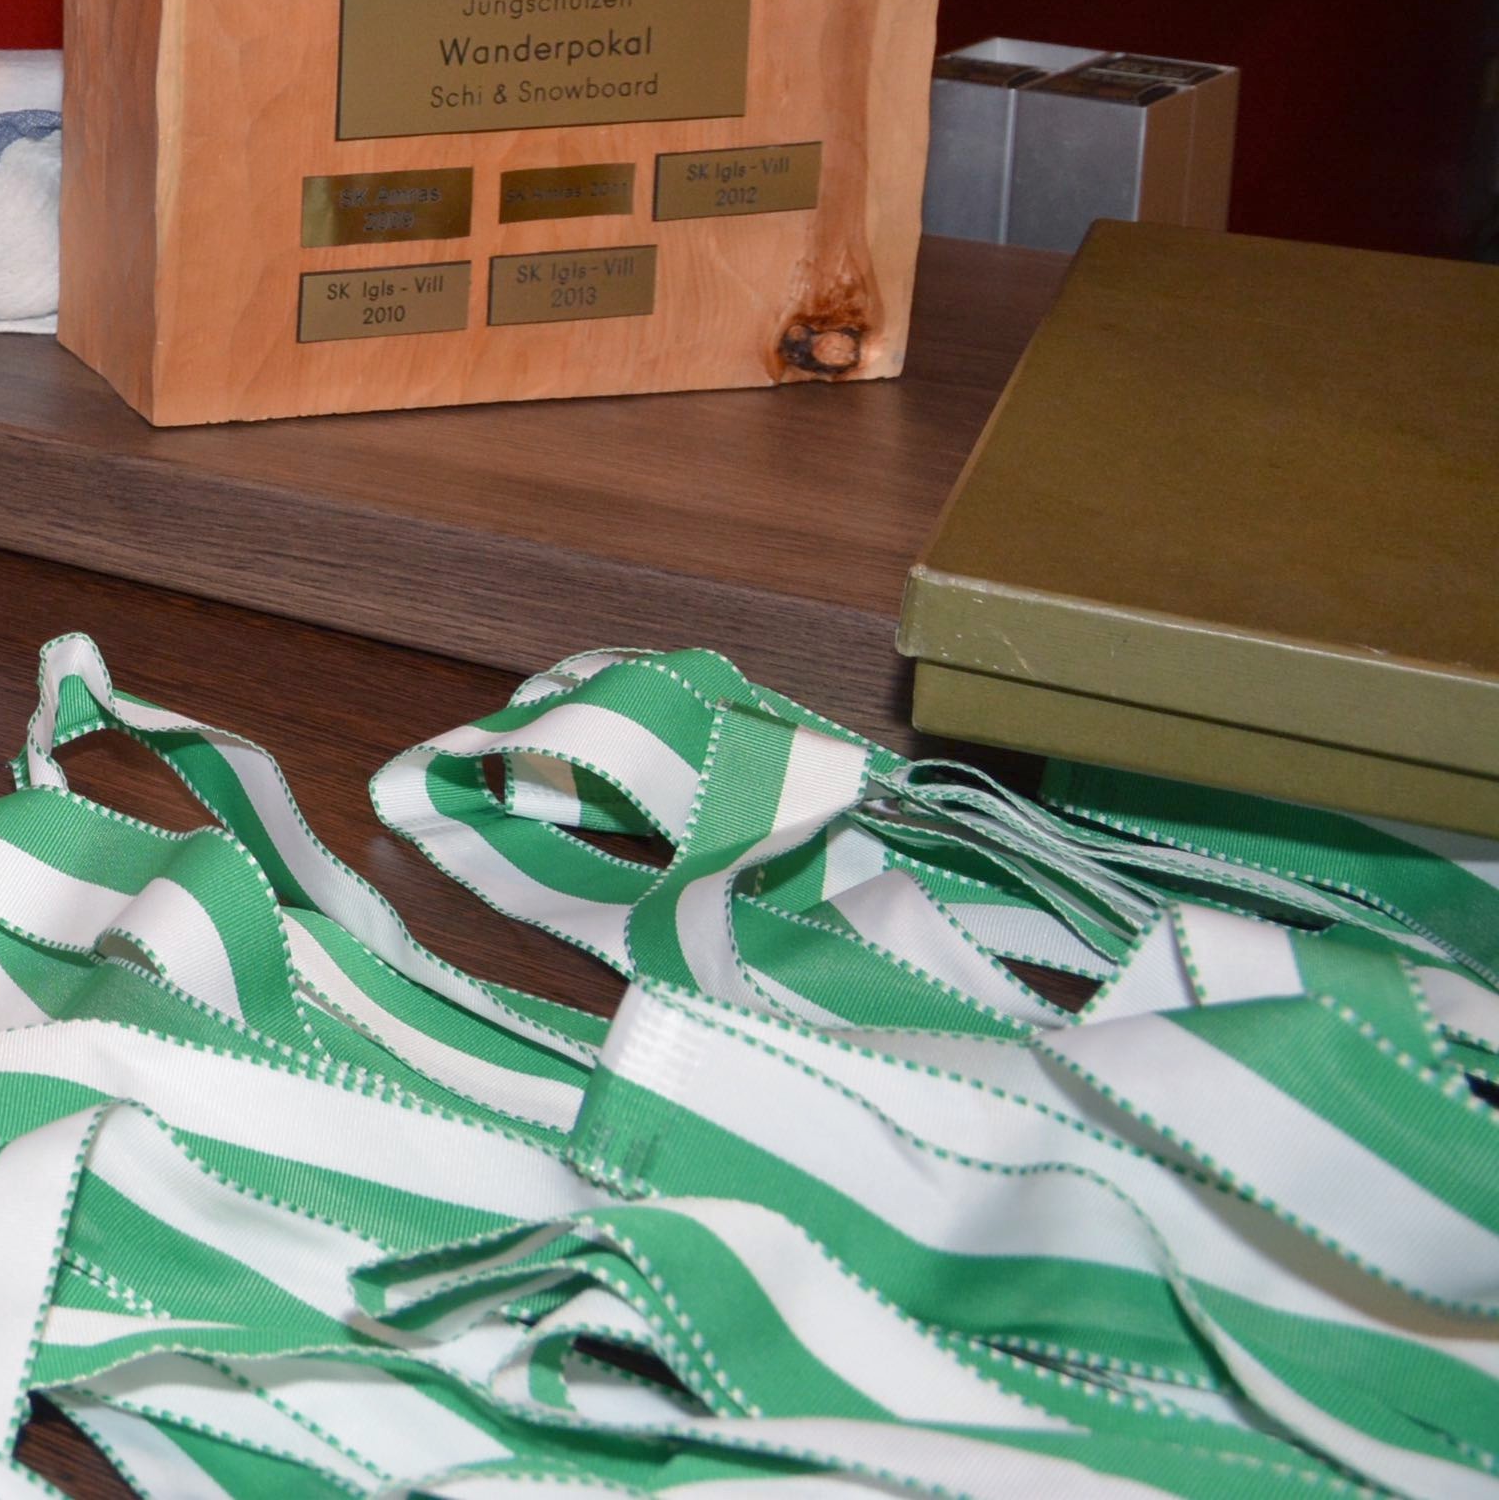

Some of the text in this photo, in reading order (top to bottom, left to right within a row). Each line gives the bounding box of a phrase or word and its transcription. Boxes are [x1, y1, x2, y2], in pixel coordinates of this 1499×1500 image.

[439, 26, 652, 66] Wanderpokal
[430, 72, 659, 108] Schi & Snowboard
[685, 162, 709, 182] SK
[714, 186, 759, 207] 2012
[515, 262, 542, 285] SK
[326, 283, 351, 301] SK
[551, 286, 598, 309] 2013
[362, 305, 406, 325] 2010
